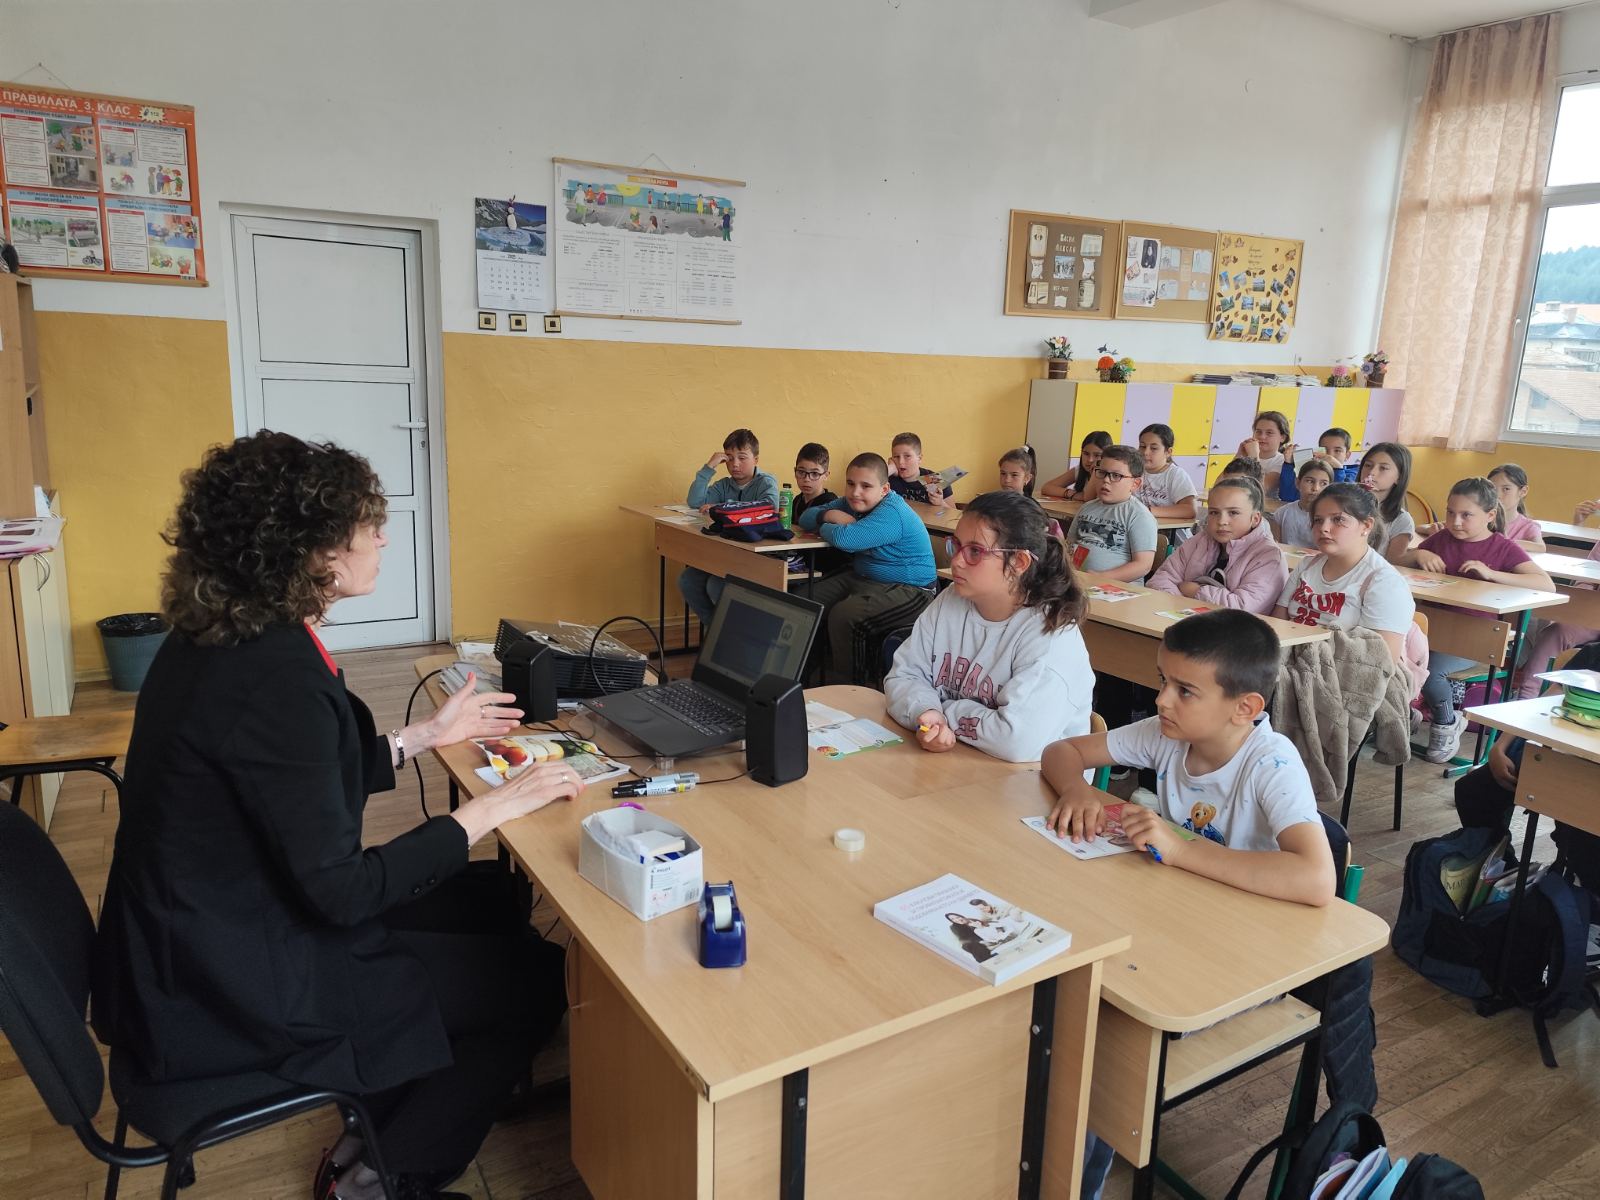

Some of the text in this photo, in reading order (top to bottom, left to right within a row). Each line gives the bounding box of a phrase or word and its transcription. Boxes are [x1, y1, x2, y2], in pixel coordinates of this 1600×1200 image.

[2, 91, 131, 115] ПРАВИЛАТА 3. КЛАС
